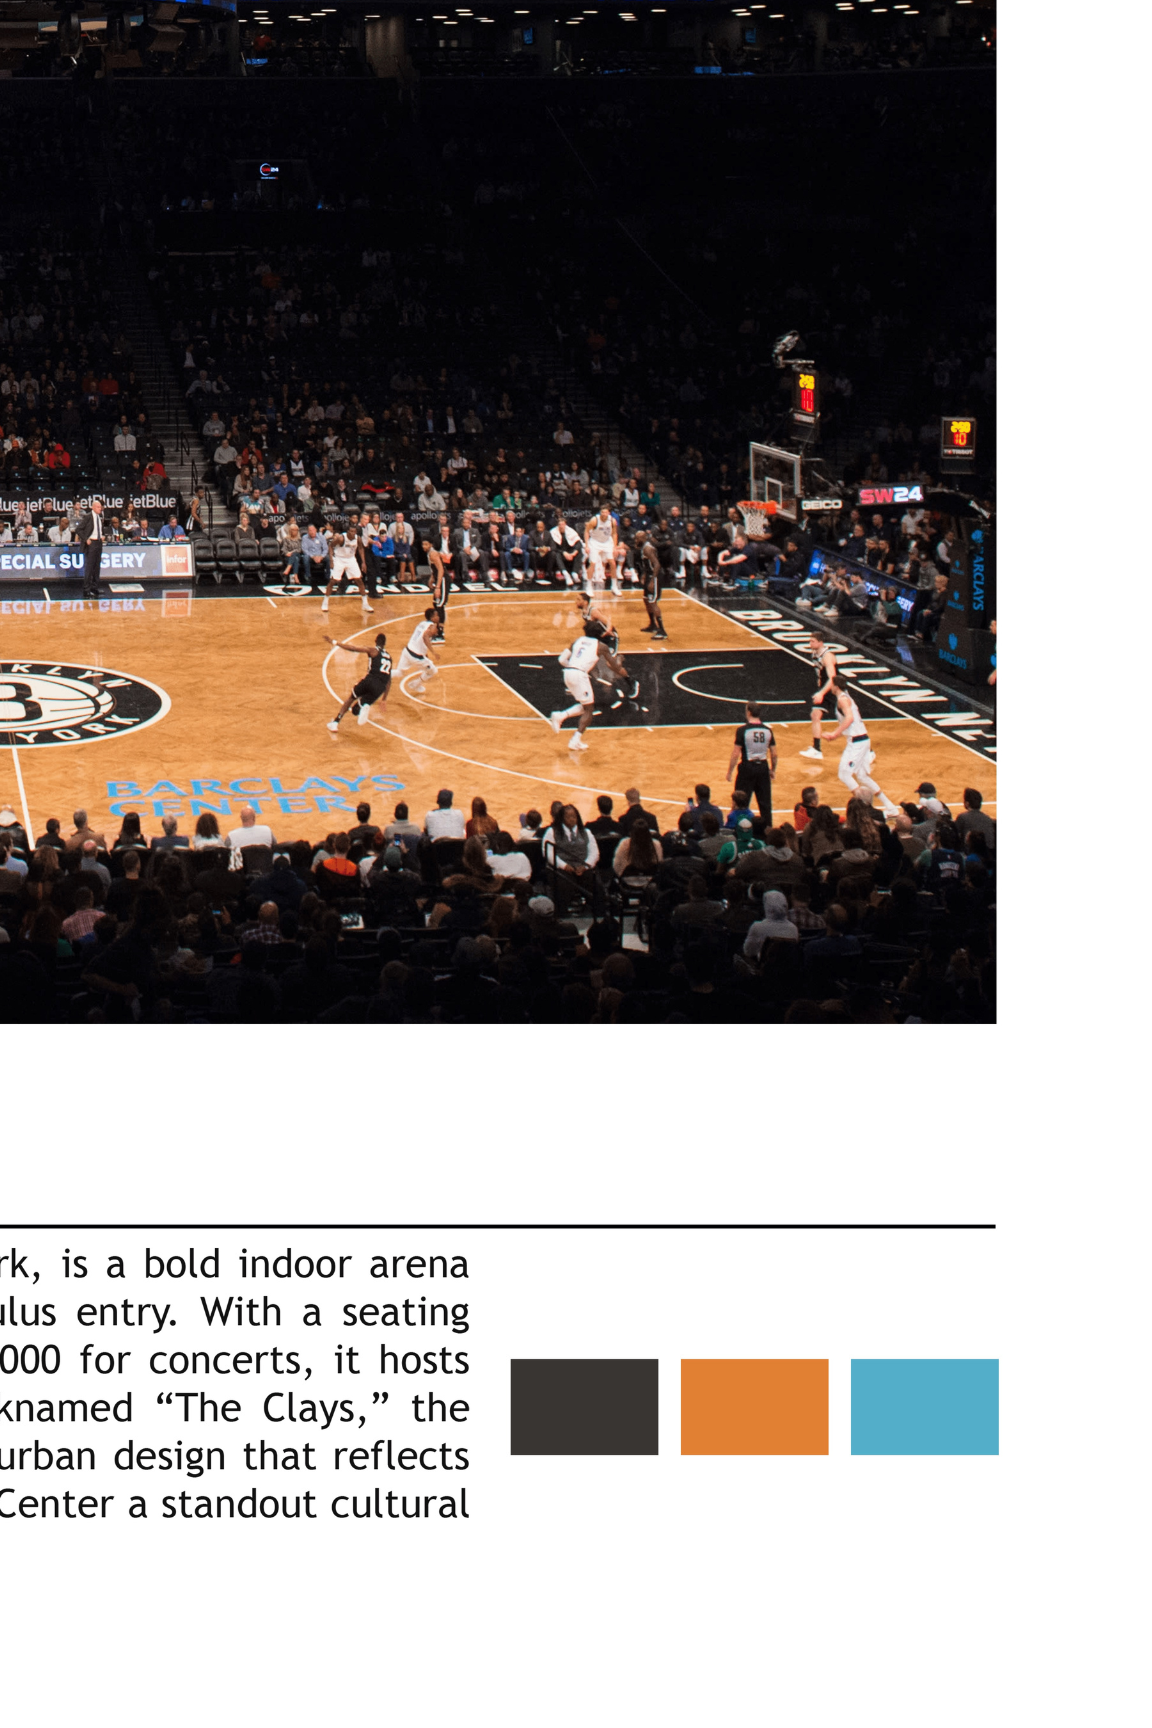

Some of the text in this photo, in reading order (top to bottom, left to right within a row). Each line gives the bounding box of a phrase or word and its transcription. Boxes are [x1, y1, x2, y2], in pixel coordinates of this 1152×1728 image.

[130, 493, 177, 510] jetBlue
[859, 485, 924, 504] SW24
[801, 499, 843, 510] GEICO
[59, 552, 146, 570] SUGERY
[16, 715, 140, 744] YORK
[753, 731, 765, 744] 58
[106, 775, 406, 798] BARCLAYS
[109, 795, 360, 817] CENTER
